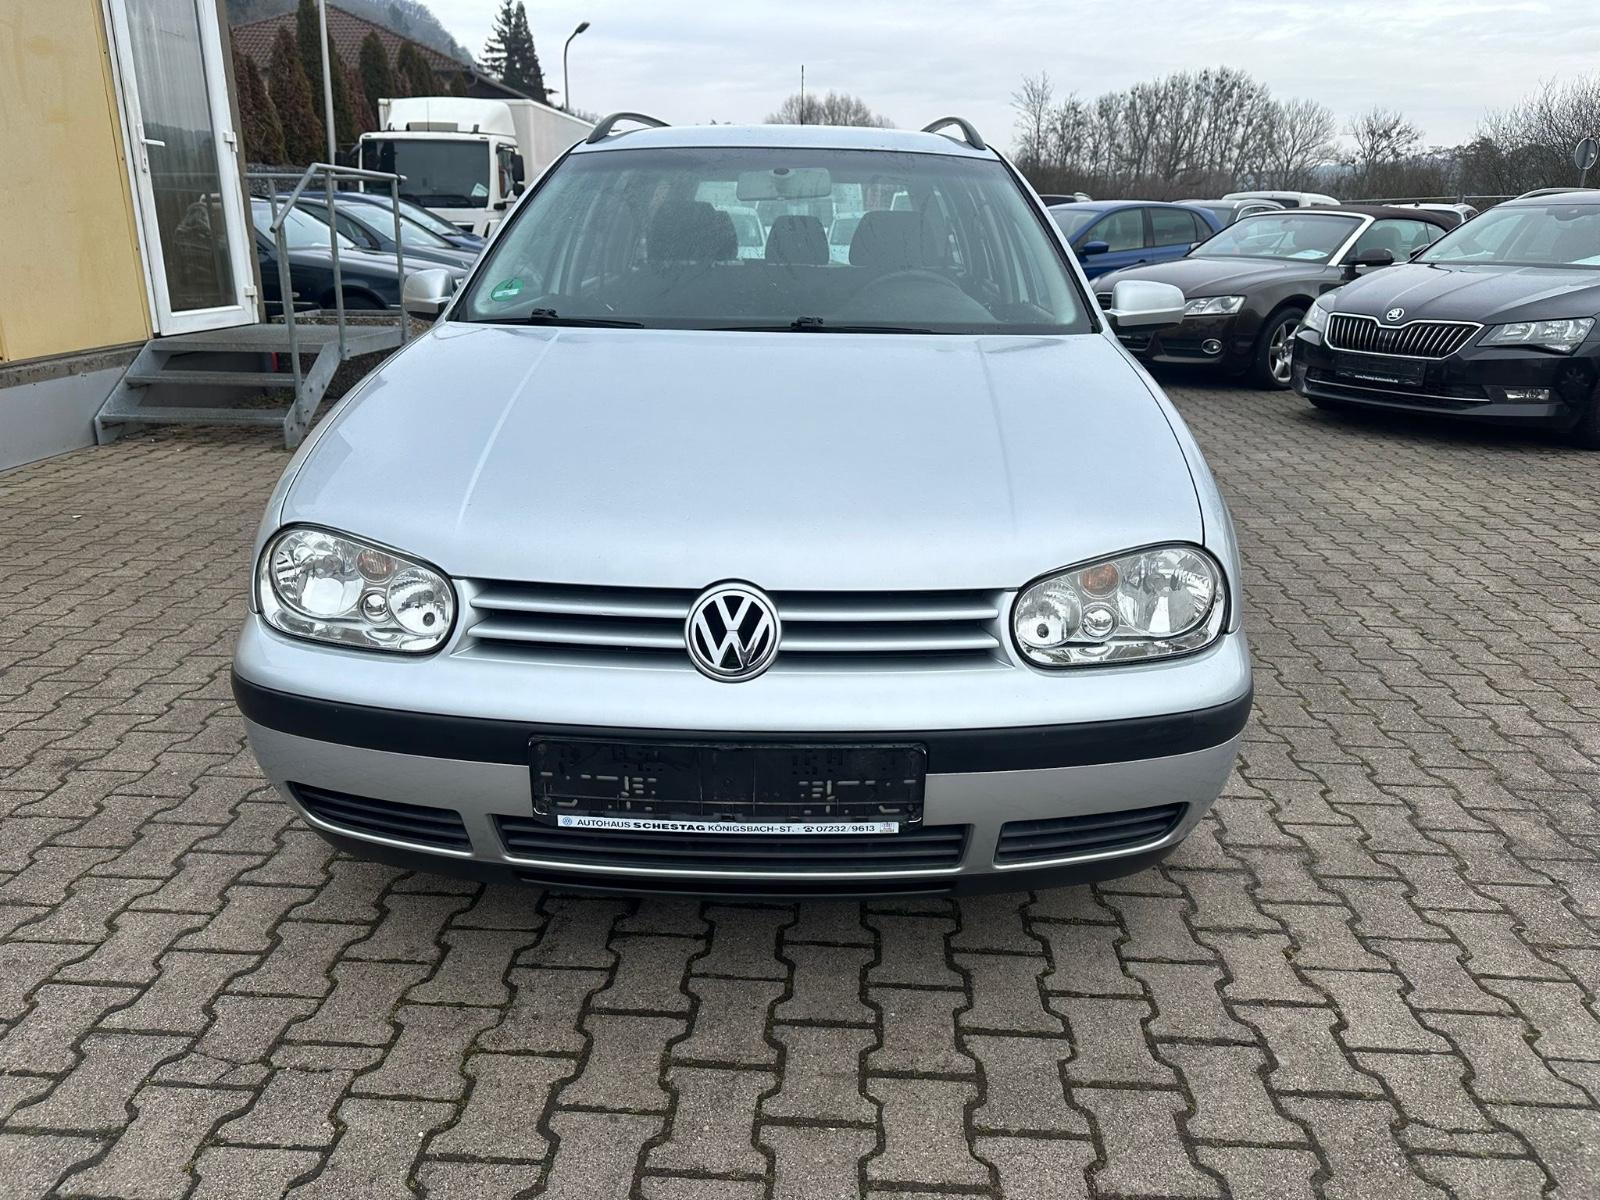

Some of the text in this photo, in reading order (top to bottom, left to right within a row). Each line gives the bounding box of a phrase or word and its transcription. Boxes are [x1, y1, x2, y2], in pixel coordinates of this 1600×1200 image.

[692, 590, 773, 673] VW
[577, 819, 631, 828] AUTOHAUS
[633, 822, 706, 831] SCHESTAG
[708, 823, 795, 832] KÖNIGSBACH-ST.
